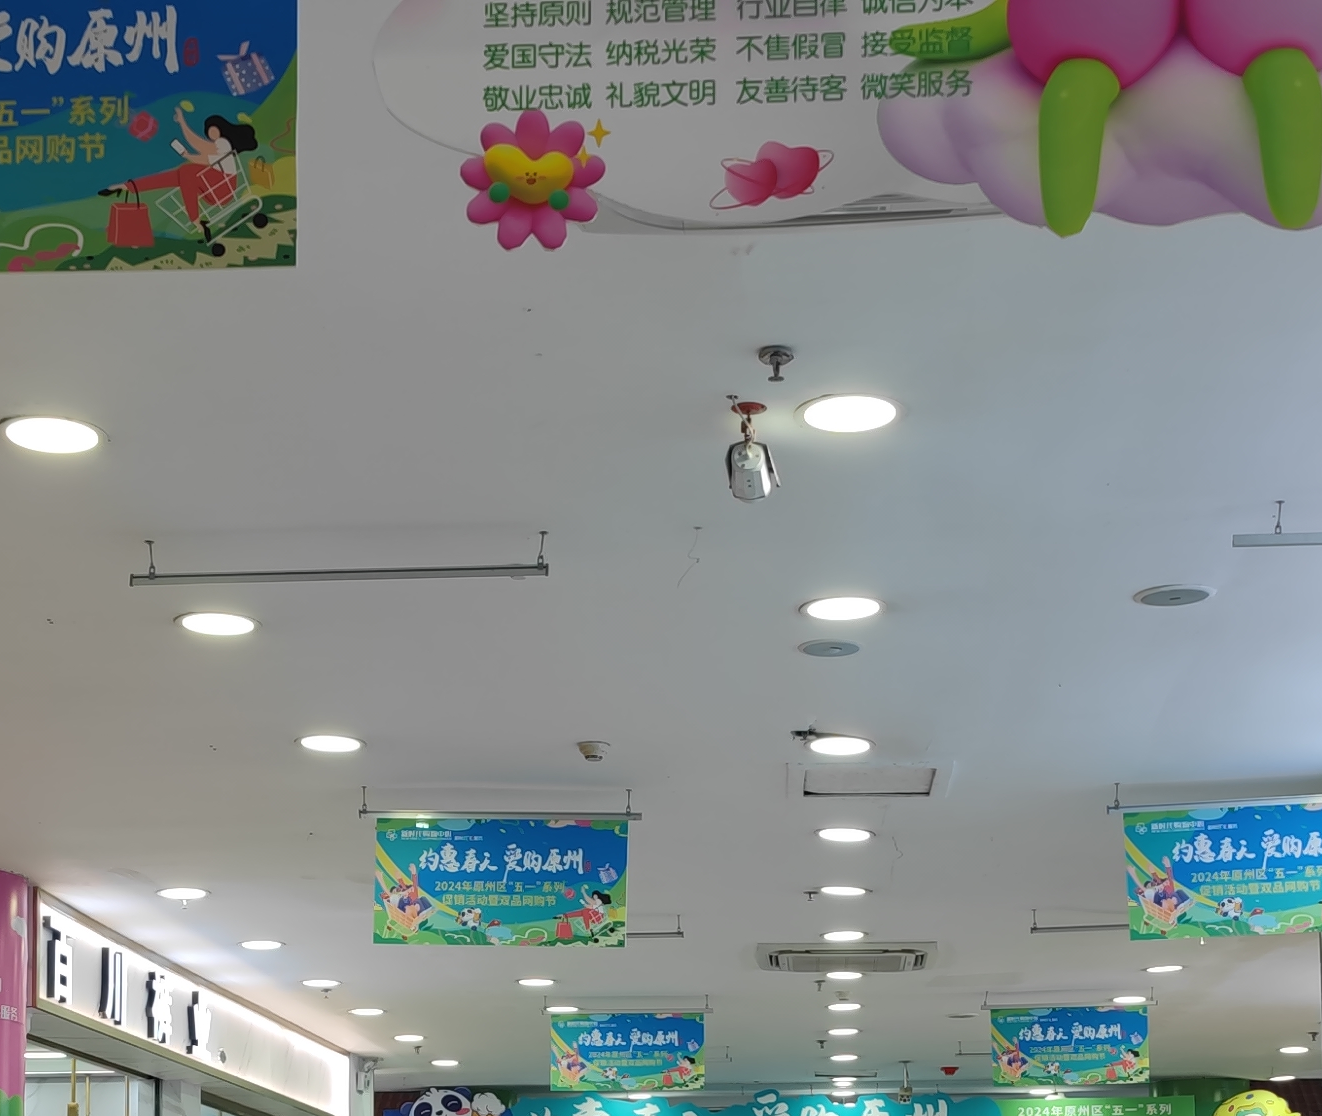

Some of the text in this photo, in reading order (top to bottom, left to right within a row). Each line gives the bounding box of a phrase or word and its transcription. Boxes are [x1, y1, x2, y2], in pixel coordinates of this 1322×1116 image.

[483, 0, 592, 28] 坚持原则
[483, 25, 974, 71] 爱国守法 纳税光荣 不售假冒 接受监督
[483, 69, 974, 113] 敬业忠诚 礼貌文明 友善待客 微笑服务
[419, 842, 583, 883] 约惠春天 爱购原州
[1172, 833, 1256, 864] 约惠春天
[1019, 1022, 1122, 1048] 约惠春天 爱购原州
